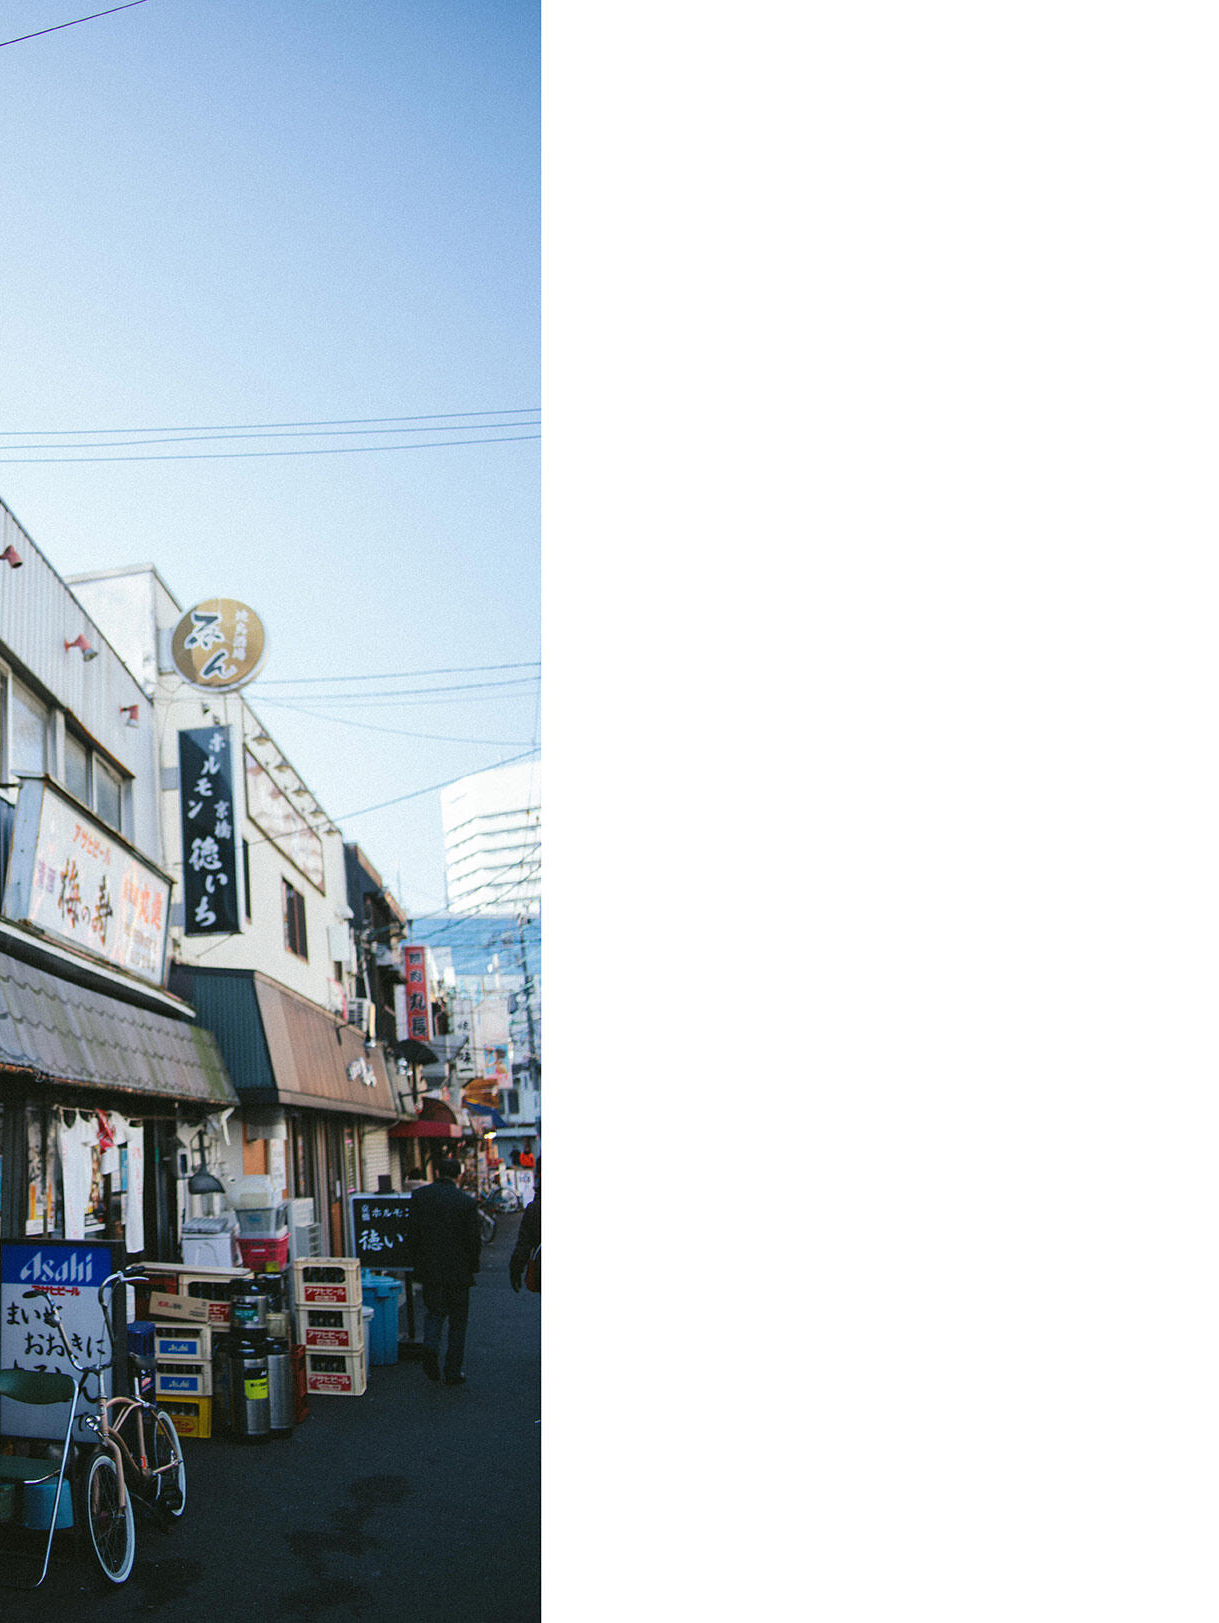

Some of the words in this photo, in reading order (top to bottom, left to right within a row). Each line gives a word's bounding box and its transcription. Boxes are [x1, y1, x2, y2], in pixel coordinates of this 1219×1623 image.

[188, 732, 225, 819] ホルモン
[214, 800, 231, 839] 京橋
[73, 824, 110, 865] アサヒビール
[188, 836, 228, 926] 徳いち
[359, 1229, 405, 1251] 徳い
[20, 1251, 93, 1283] Asahi
[306, 1287, 346, 1296] アサヒビール
[308, 1330, 348, 1340] アサヒビール
[309, 1375, 350, 1385] アサヒビール
